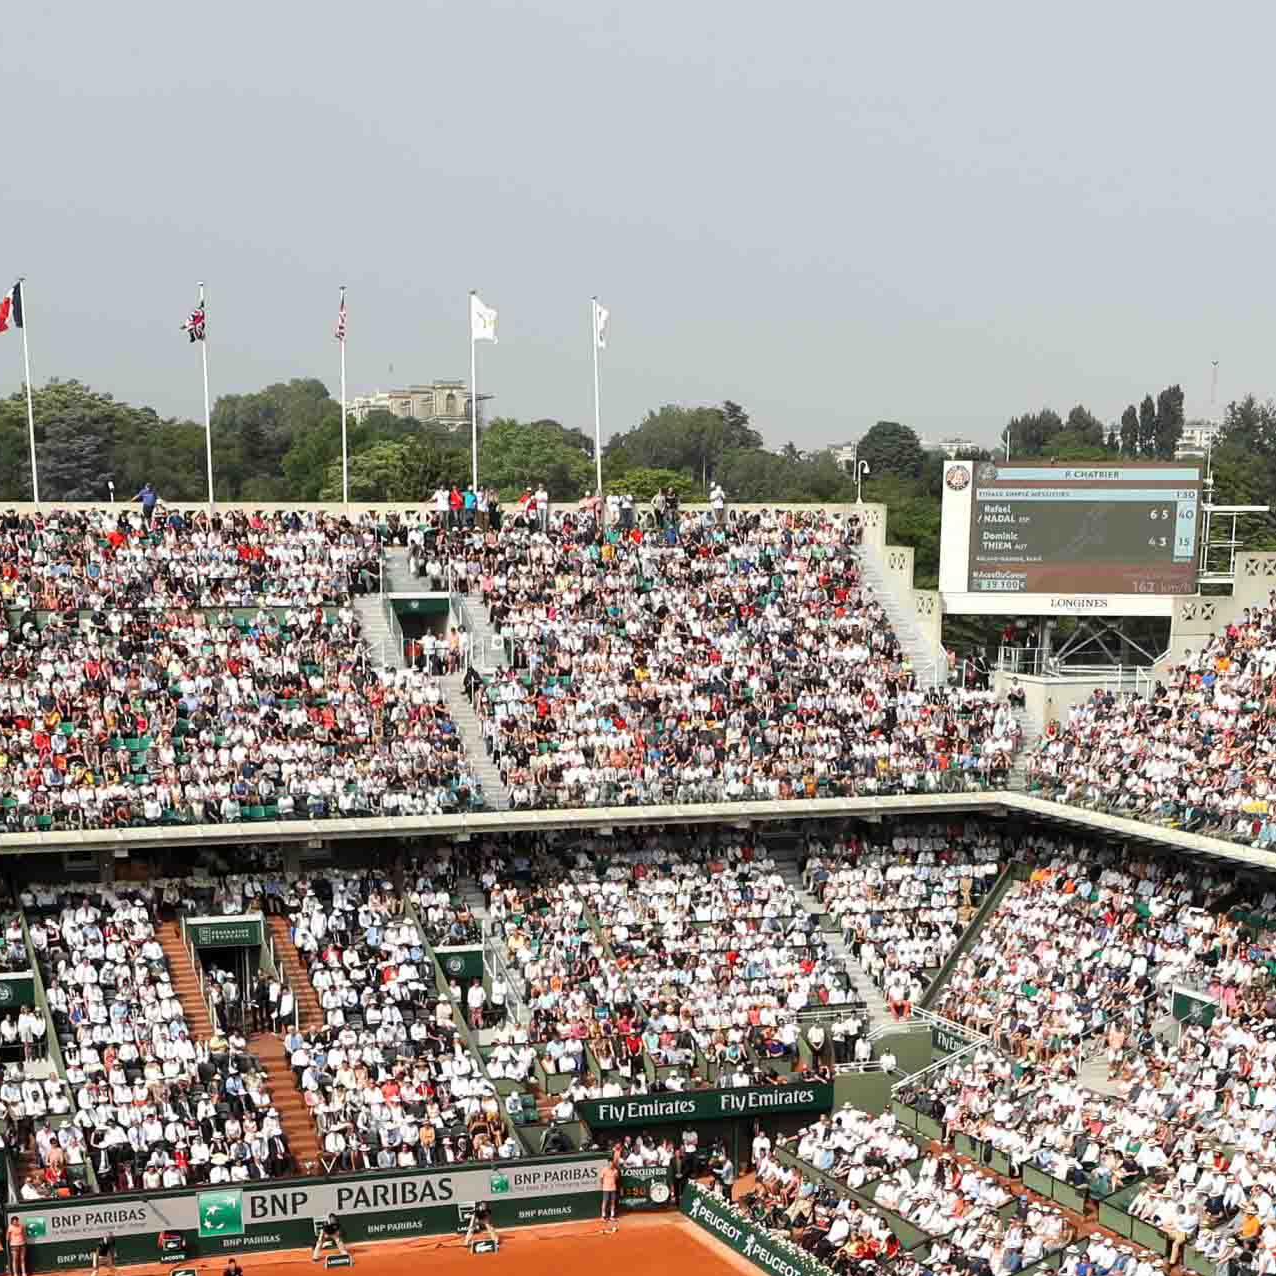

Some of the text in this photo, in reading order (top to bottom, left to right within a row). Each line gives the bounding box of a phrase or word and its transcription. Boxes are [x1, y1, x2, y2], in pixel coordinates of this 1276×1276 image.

[984, 504, 1011, 513] Rafael
[983, 514, 1015, 522] NADAL
[1150, 509, 1169, 520] 6 5
[1178, 510, 1194, 520] 40
[982, 531, 1019, 540] Dominic
[982, 541, 1012, 550] THIEM
[1179, 537, 1190, 546] 15
[1132, 582, 1156, 593] 162
[1050, 598, 1108, 609] LONGINES
[721, 1088, 814, 1112] Fly Emirates
[598, 1099, 696, 1122] Fly Emirates
[514, 1173, 541, 1186] BNP
[544, 1167, 598, 1183] PARIBAS
[619, 1167, 667, 1177] LONGINES
[250, 1178, 453, 1218] BNP PARIBAS
[519, 1206, 572, 1218] BNP PARIBAS
[51, 1215, 81, 1229] BNP
[85, 1208, 147, 1225] PARIBAS
[698, 1205, 743, 1242] PEUGEOT
[367, 1220, 423, 1233] BNP PARIBAS
[223, 1234, 281, 1248] BNP PARIBAS
[57, 1254, 77, 1264] BNP
[161, 1254, 186, 1262] LACOSTE
